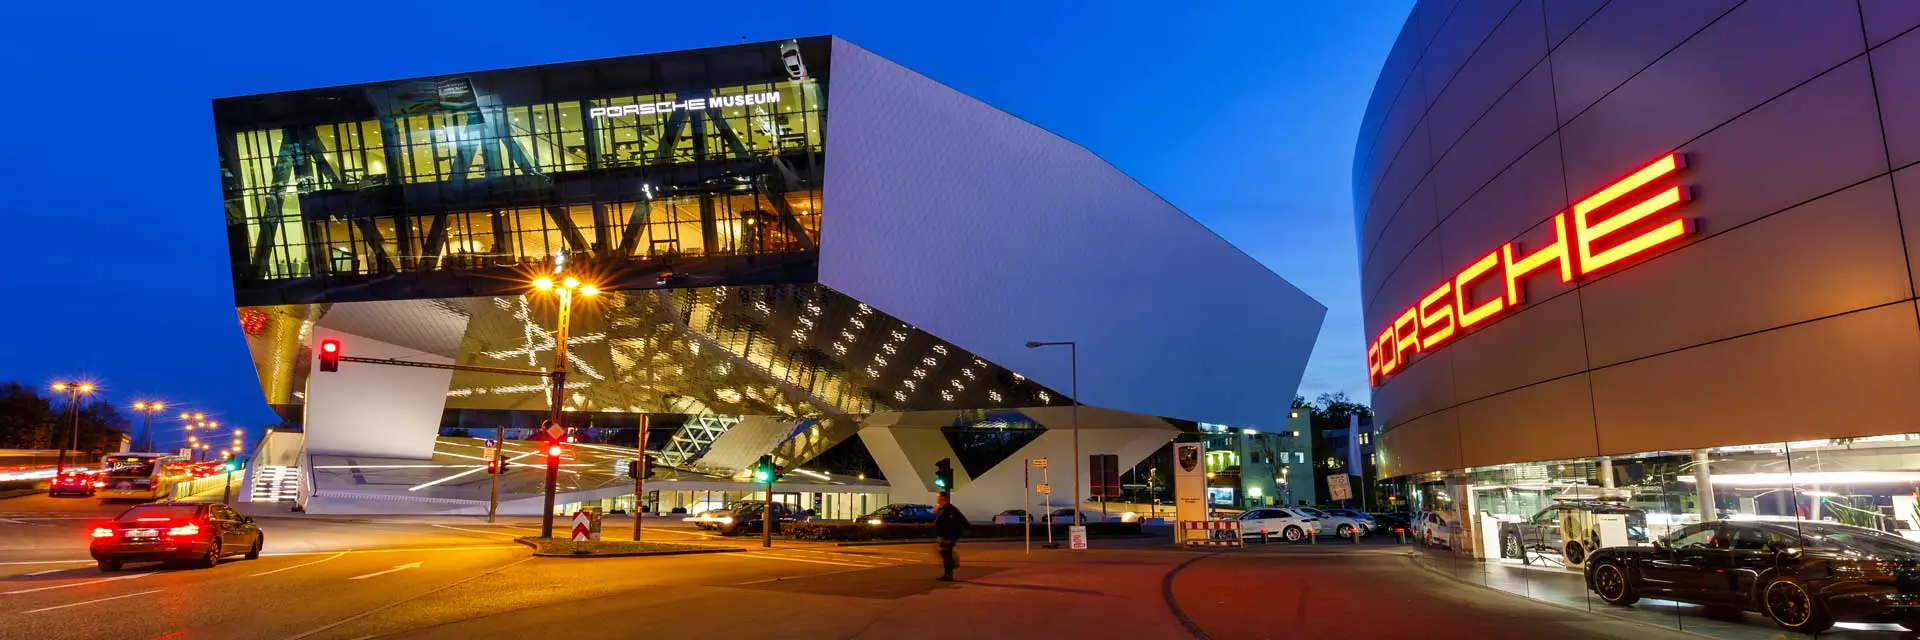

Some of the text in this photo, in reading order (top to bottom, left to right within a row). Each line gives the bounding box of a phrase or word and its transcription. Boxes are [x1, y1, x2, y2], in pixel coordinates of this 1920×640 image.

[590, 92, 780, 117] PORSCHE MUSEUM
[1368, 151, 1692, 387] PORSCHE
